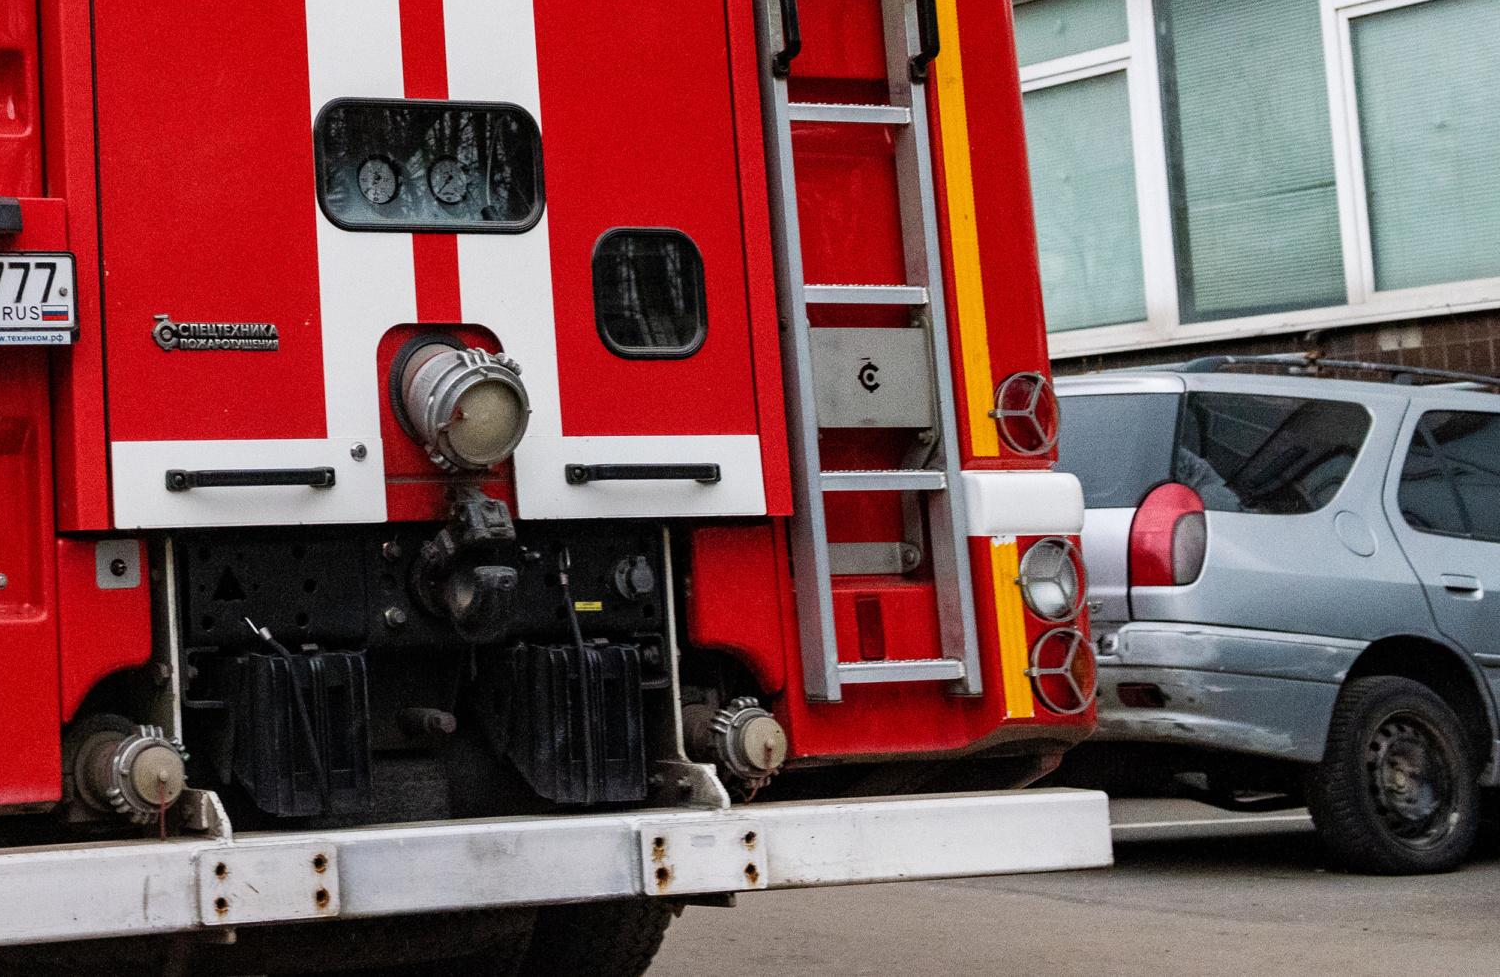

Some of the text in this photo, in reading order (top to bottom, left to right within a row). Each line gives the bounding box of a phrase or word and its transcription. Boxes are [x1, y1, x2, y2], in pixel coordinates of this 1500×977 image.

[2, 305, 41, 321] RUS
[178, 323, 279, 337] СПЕЦТЕХНИКА
[179, 338, 280, 350] ПОЖАРОТУШЕНИЯ
